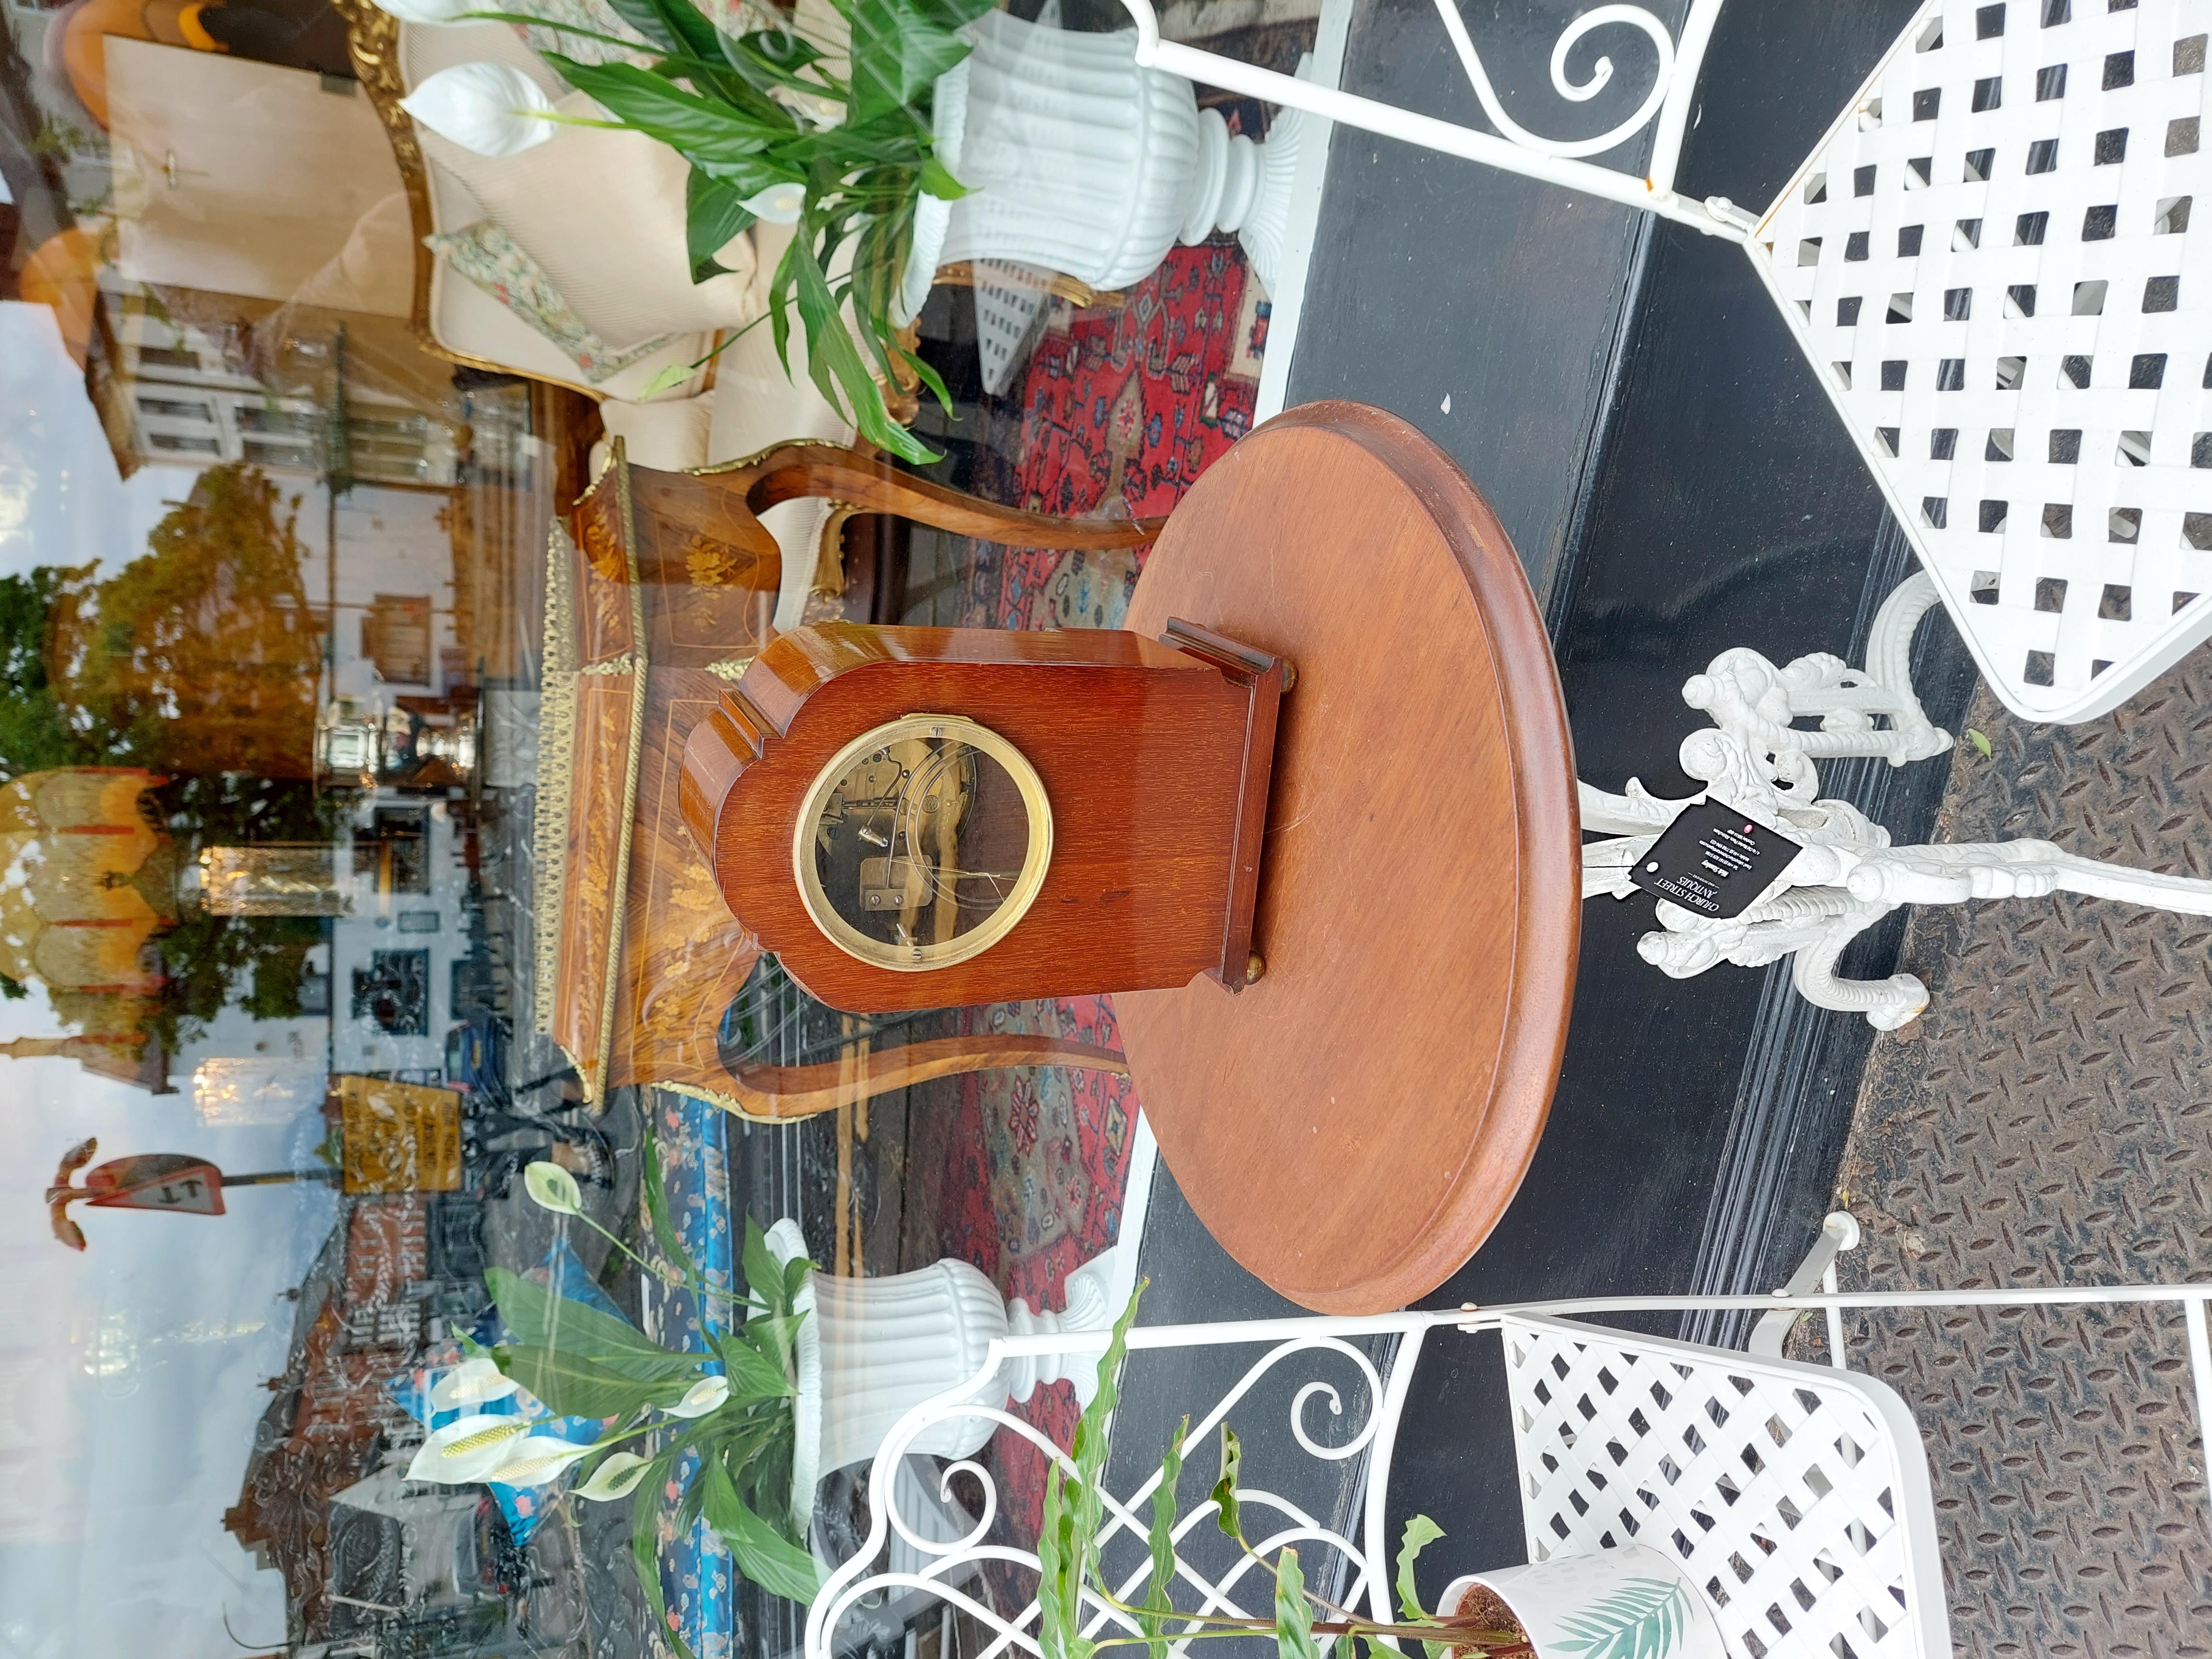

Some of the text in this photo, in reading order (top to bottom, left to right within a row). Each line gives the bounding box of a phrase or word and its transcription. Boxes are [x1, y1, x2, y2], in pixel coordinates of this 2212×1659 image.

[1701, 859, 1729, 877] Nick Stanley
[1653, 878, 1719, 911] CHURCH STREET
[1676, 876, 1718, 899] ANTIQUES
